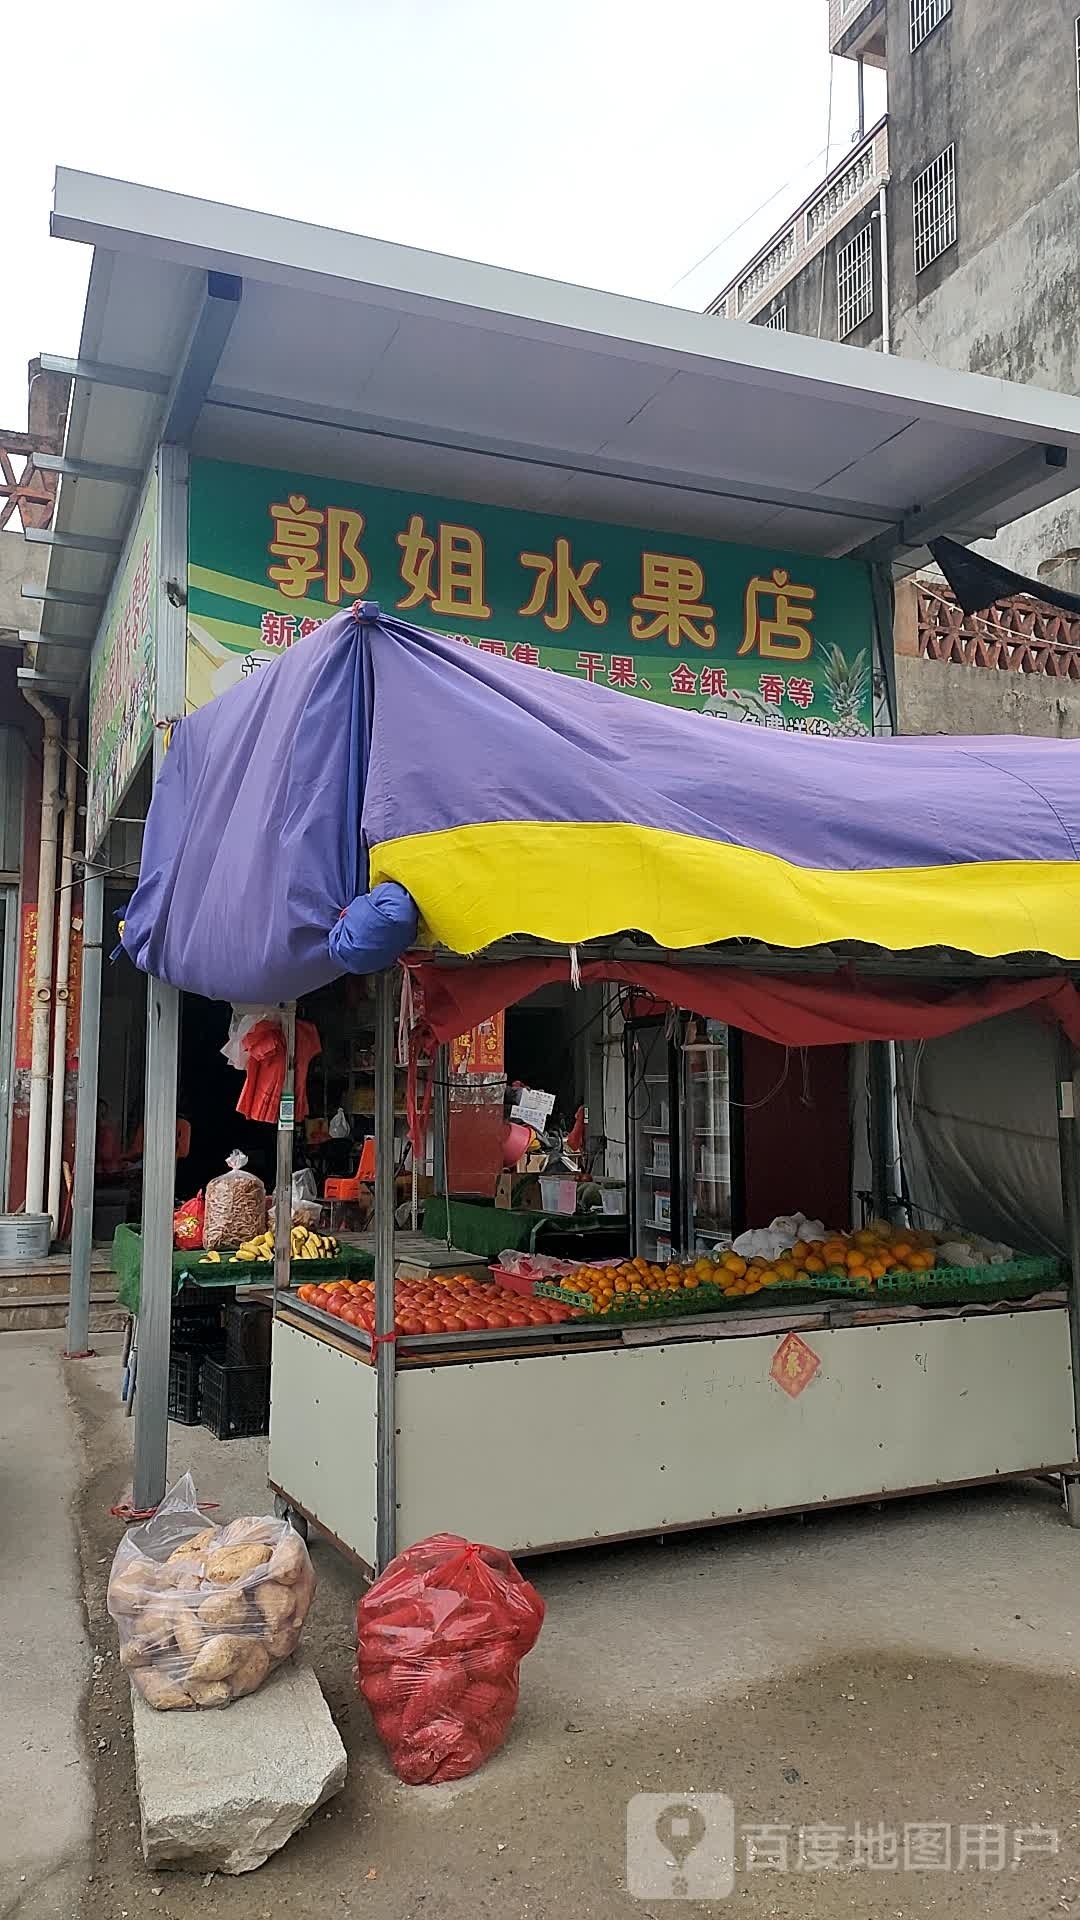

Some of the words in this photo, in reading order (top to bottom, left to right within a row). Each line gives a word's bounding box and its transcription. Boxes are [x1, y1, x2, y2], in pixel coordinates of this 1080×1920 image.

[267, 495, 816, 660] 郭姐水果店
